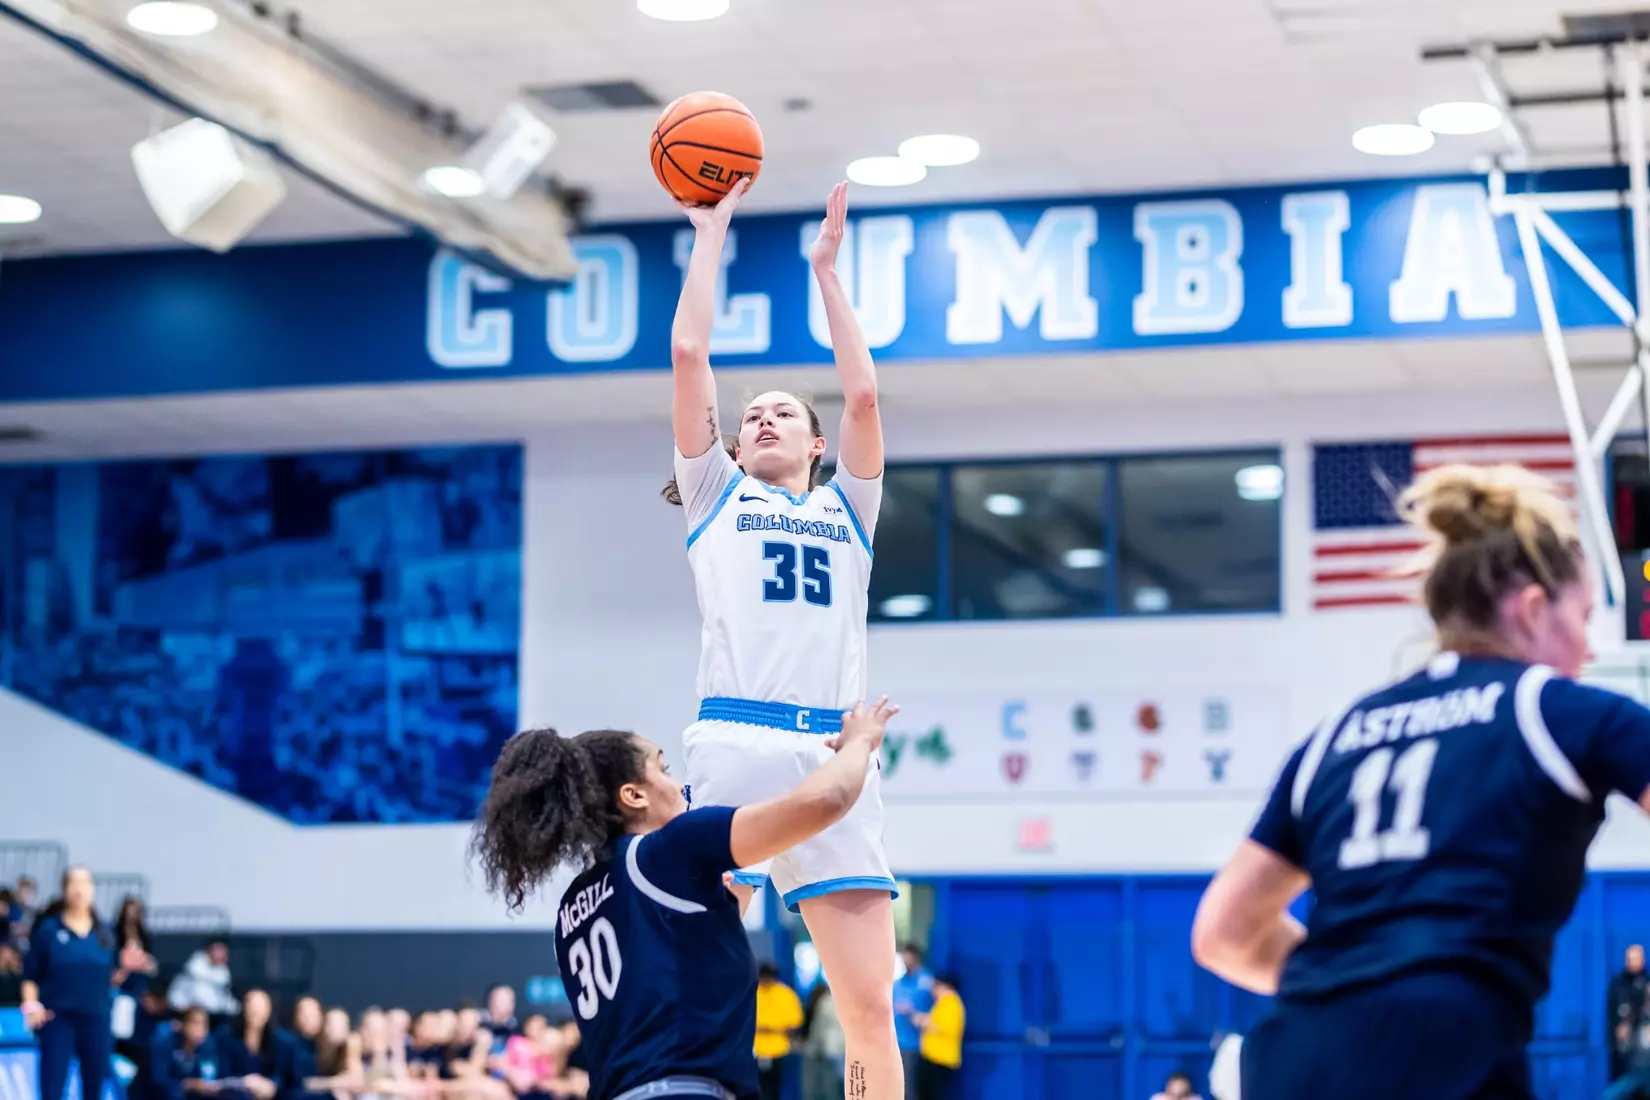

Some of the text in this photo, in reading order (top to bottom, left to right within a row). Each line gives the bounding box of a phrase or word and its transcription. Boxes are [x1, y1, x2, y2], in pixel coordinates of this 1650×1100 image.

[426, 183, 1516, 368] COLUMBIA
[737, 513, 851, 544] COLUMBIA
[762, 541, 832, 608] 35
[796, 710, 810, 730] C
[1001, 701, 1027, 740] C
[1337, 737, 1440, 870] 11
[559, 872, 615, 939] McGILL
[568, 916, 623, 1020] 30
